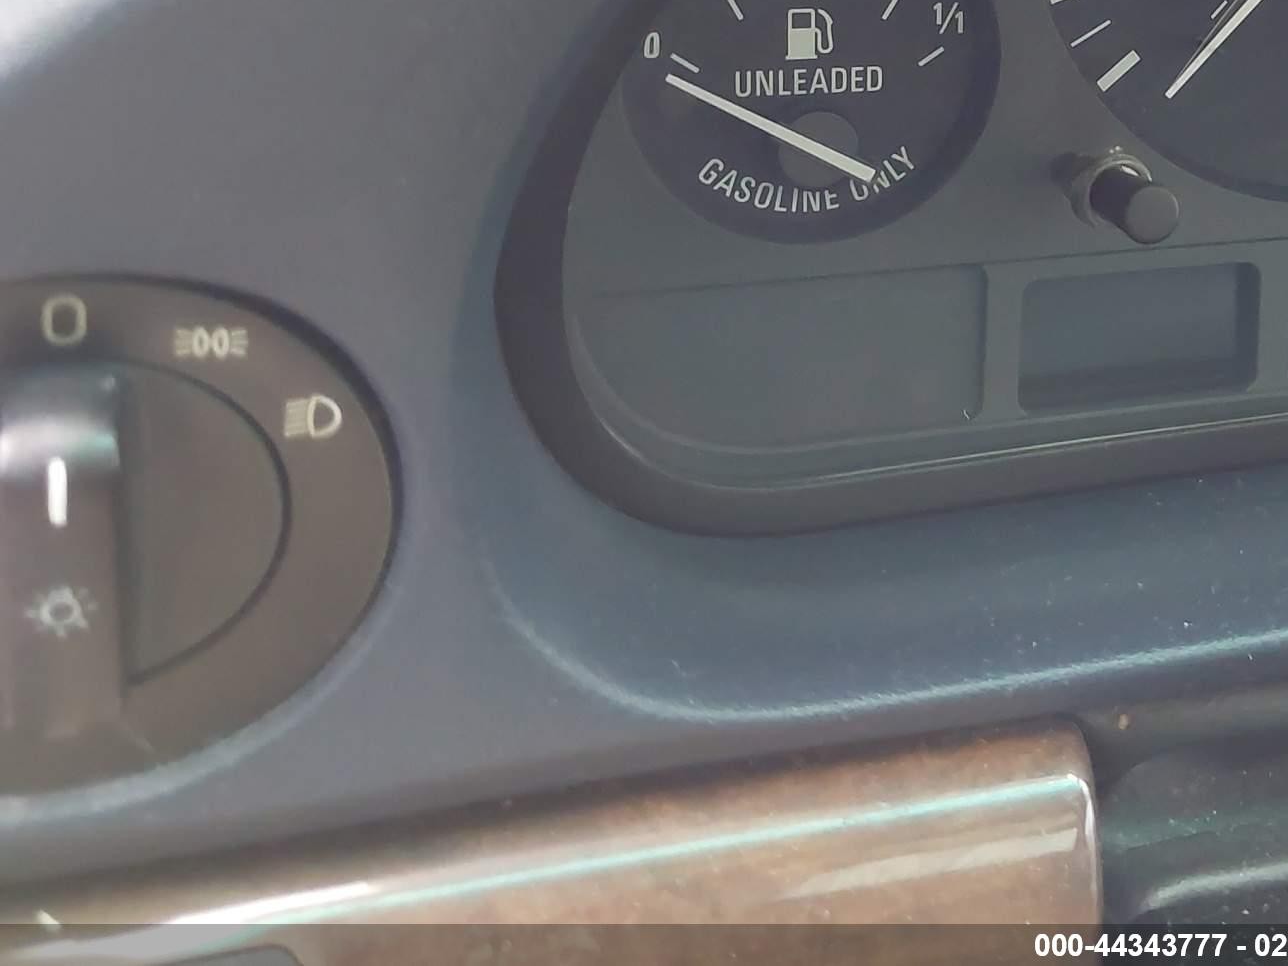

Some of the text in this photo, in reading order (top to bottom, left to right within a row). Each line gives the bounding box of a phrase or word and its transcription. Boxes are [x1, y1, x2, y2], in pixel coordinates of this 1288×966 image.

[933, 1, 964, 35] 1/1
[643, 31, 661, 59] 0
[734, 65, 883, 98] UNLEADED
[698, 145, 916, 213] GASOLINE ONLY
